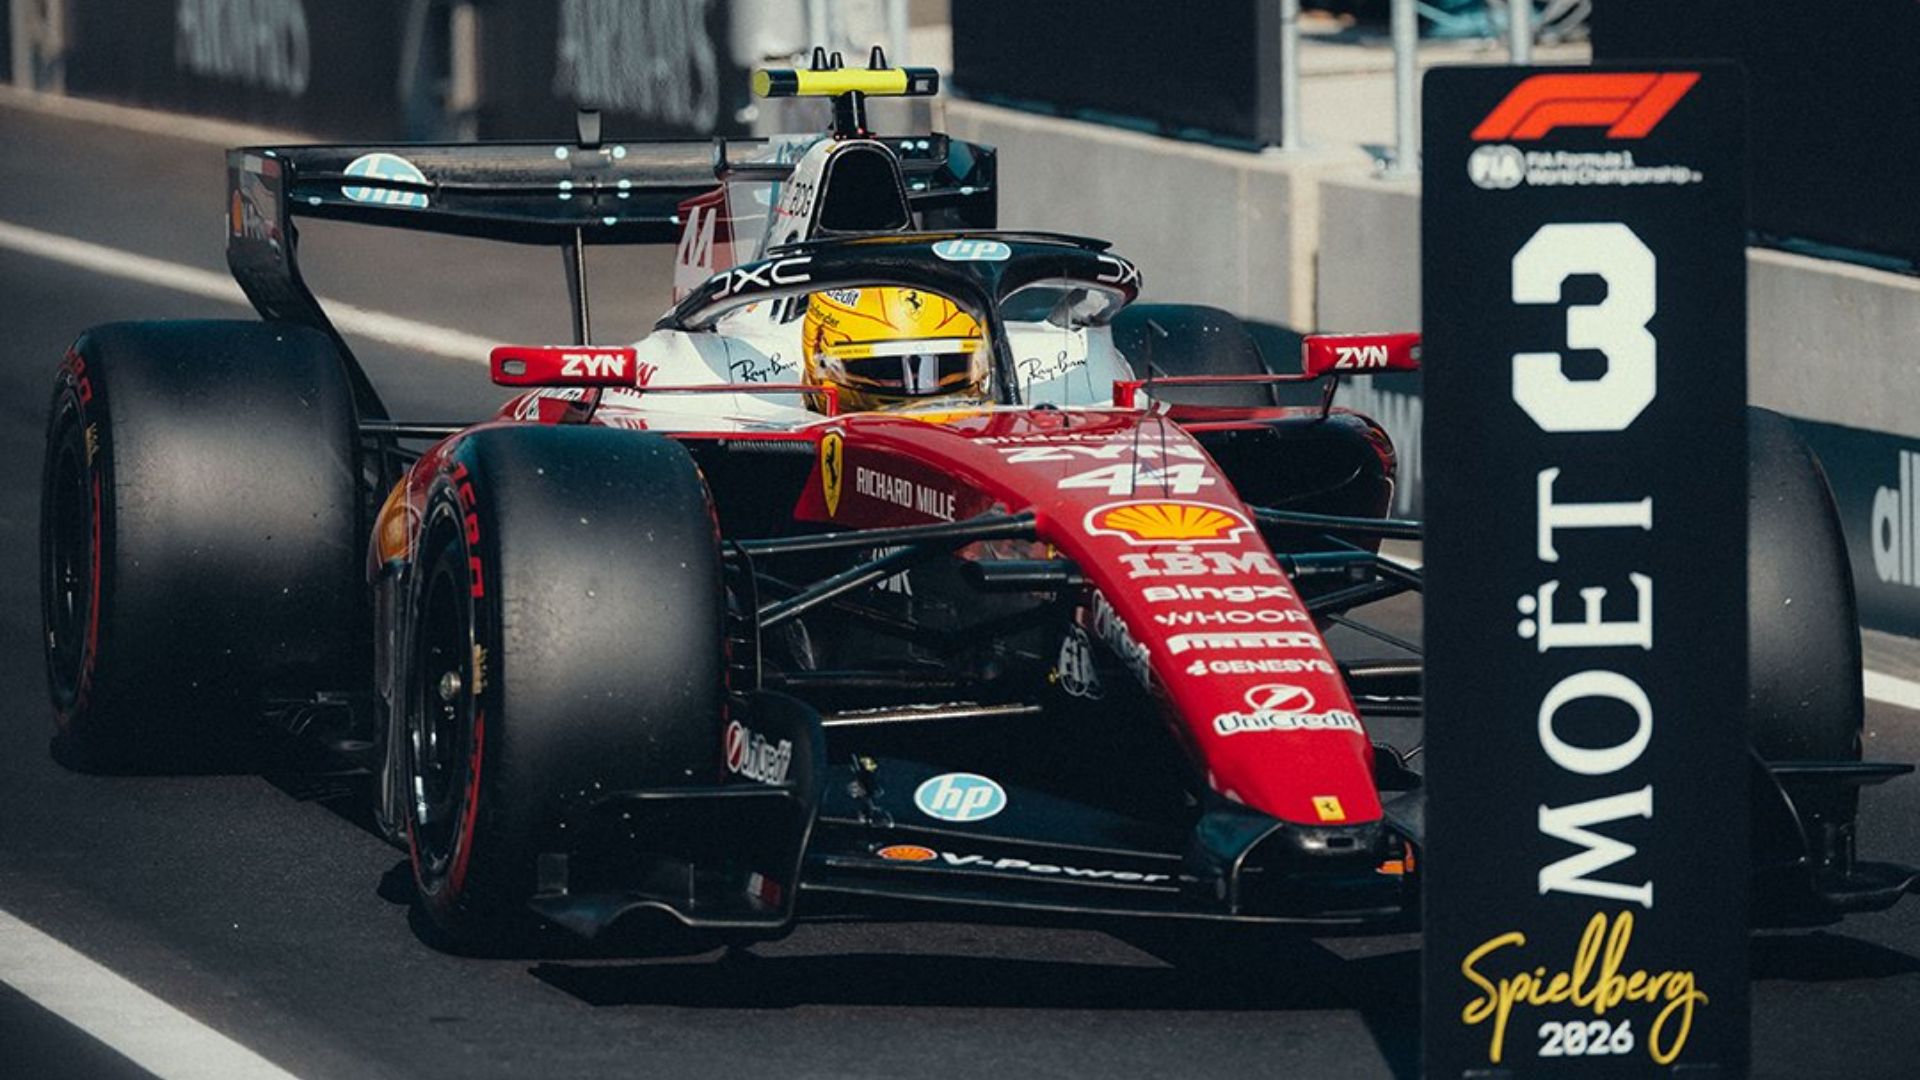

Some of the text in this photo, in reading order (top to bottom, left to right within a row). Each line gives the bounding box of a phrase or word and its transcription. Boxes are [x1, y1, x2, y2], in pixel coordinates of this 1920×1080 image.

[947, 240, 999, 259] hp
[1512, 222, 1656, 434] 3
[560, 354, 625, 377] ZYN
[1335, 345, 1388, 368] ZYN
[998, 444, 1206, 464] ZYN
[856, 466, 956, 523] RICHARD MILLE
[1057, 463, 1216, 496] 44
[1117, 551, 1283, 580] IBM
[1209, 659, 1336, 675] GENESYS
[1517, 466, 1654, 909] MOËT
[929, 776, 995, 819] hp
[941, 852, 1171, 883] V-Power
[1461, 910, 1709, 1065] Spielberg
[1538, 1019, 1634, 1057] 2026
